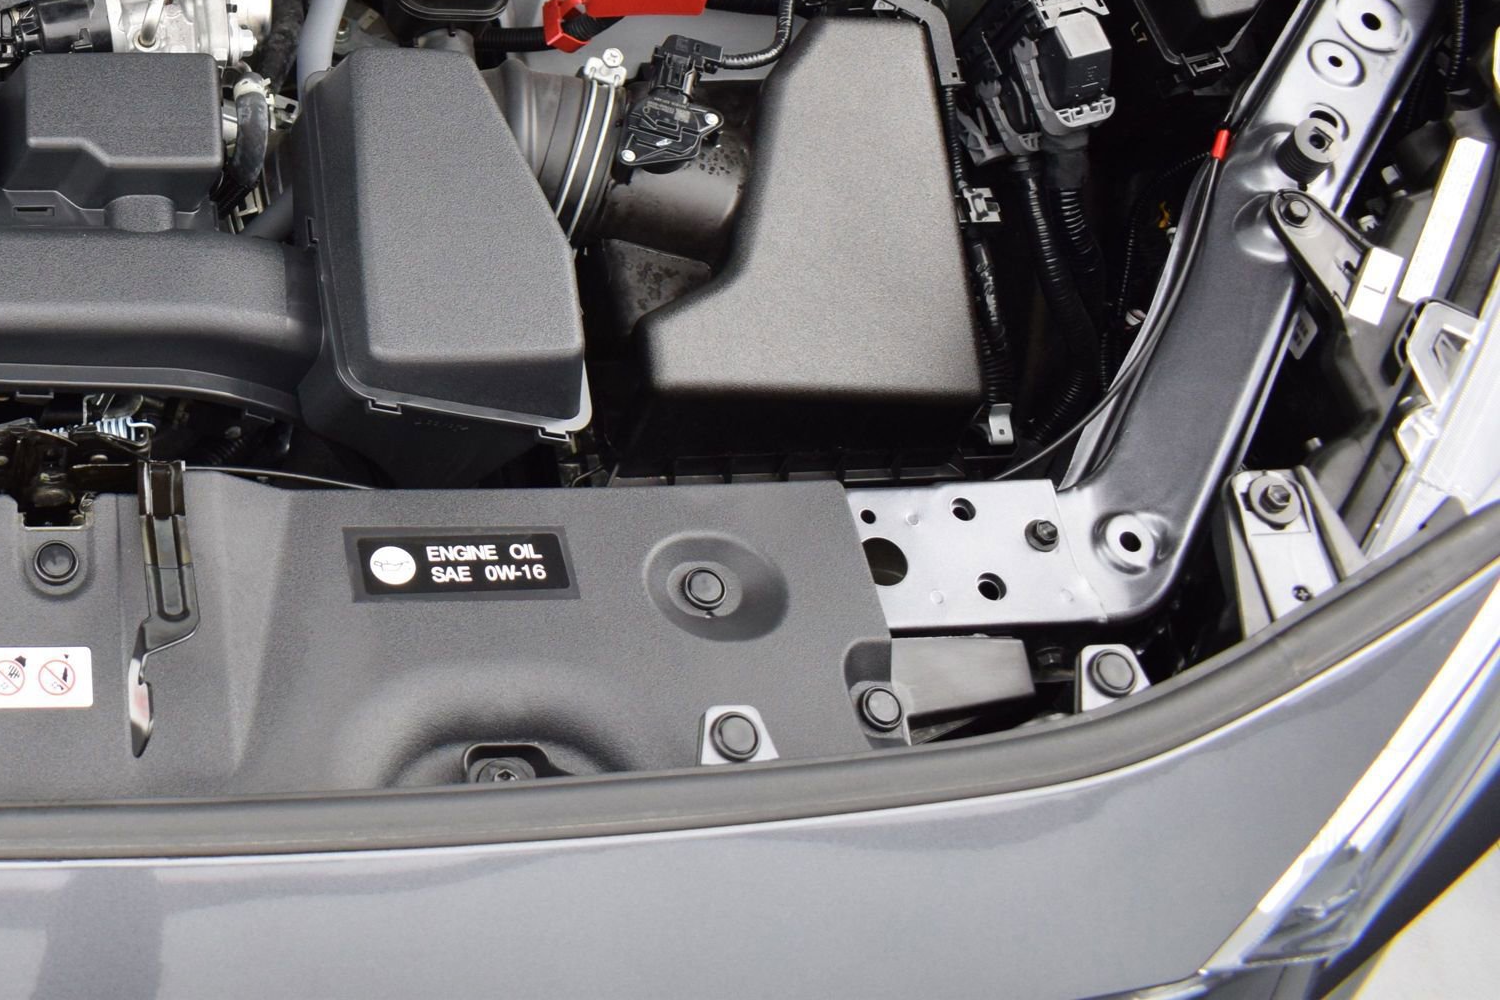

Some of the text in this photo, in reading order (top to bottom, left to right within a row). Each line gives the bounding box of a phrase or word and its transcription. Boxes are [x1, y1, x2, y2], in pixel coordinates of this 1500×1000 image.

[426, 543, 543, 562] ENGINE OIL
[431, 563, 547, 583] SAE 0W-16
